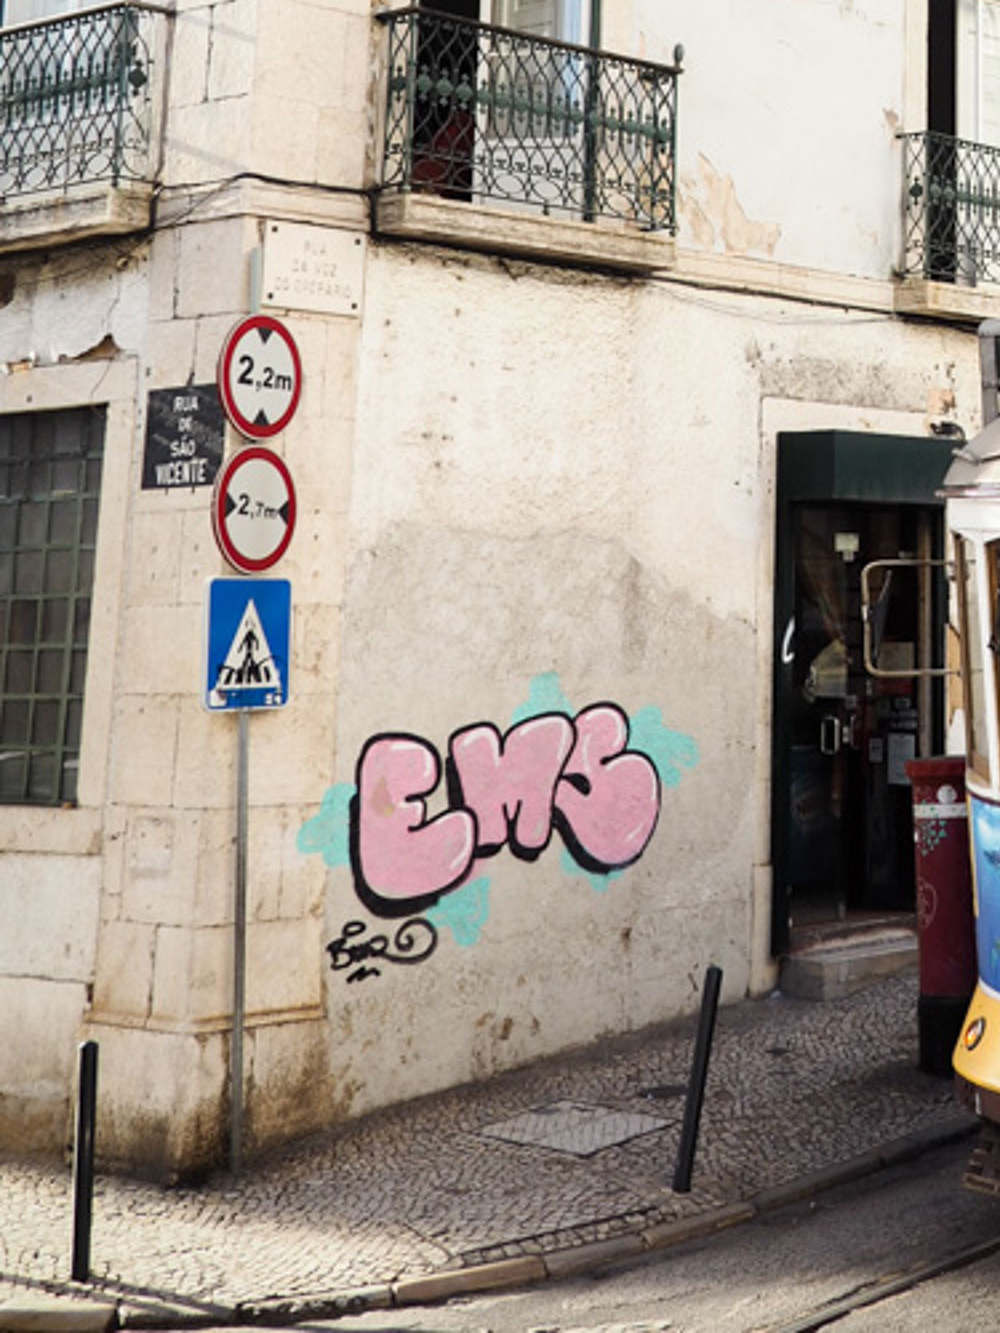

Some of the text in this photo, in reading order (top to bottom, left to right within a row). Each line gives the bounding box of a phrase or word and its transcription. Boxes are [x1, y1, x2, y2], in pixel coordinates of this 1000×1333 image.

[237, 354, 291, 392] 2,2m
[172, 396, 199, 413] RUA
[155, 458, 208, 485] VICENTE
[238, 493, 280, 520] 2,7m
